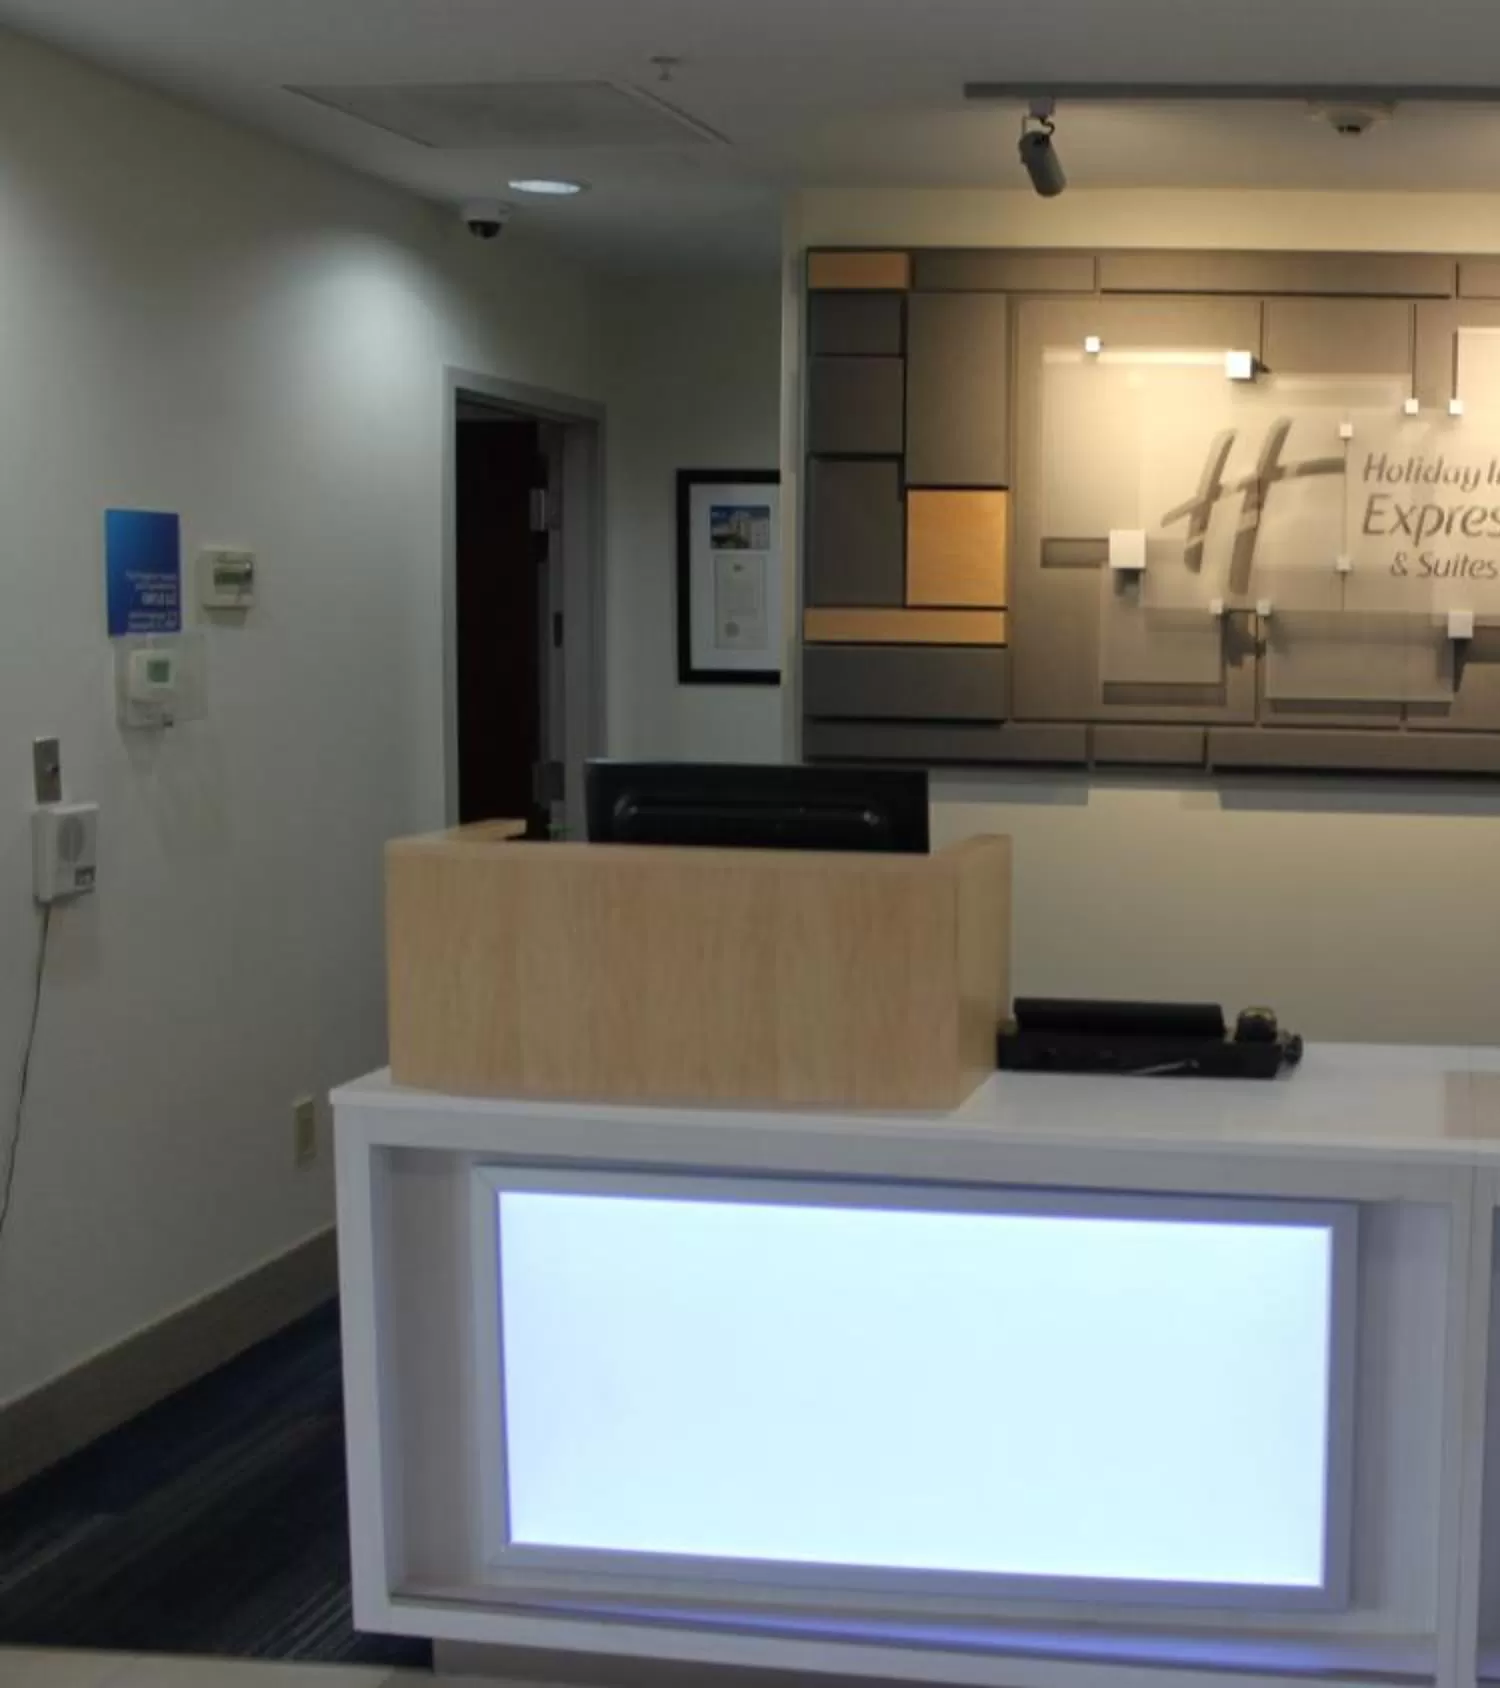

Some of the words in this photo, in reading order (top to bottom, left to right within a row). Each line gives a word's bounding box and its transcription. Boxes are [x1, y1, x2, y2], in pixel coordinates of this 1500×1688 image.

[1363, 452, 1481, 492] Holiday
[1390, 551, 1408, 577] &
[1416, 552, 1498, 580] Suites
